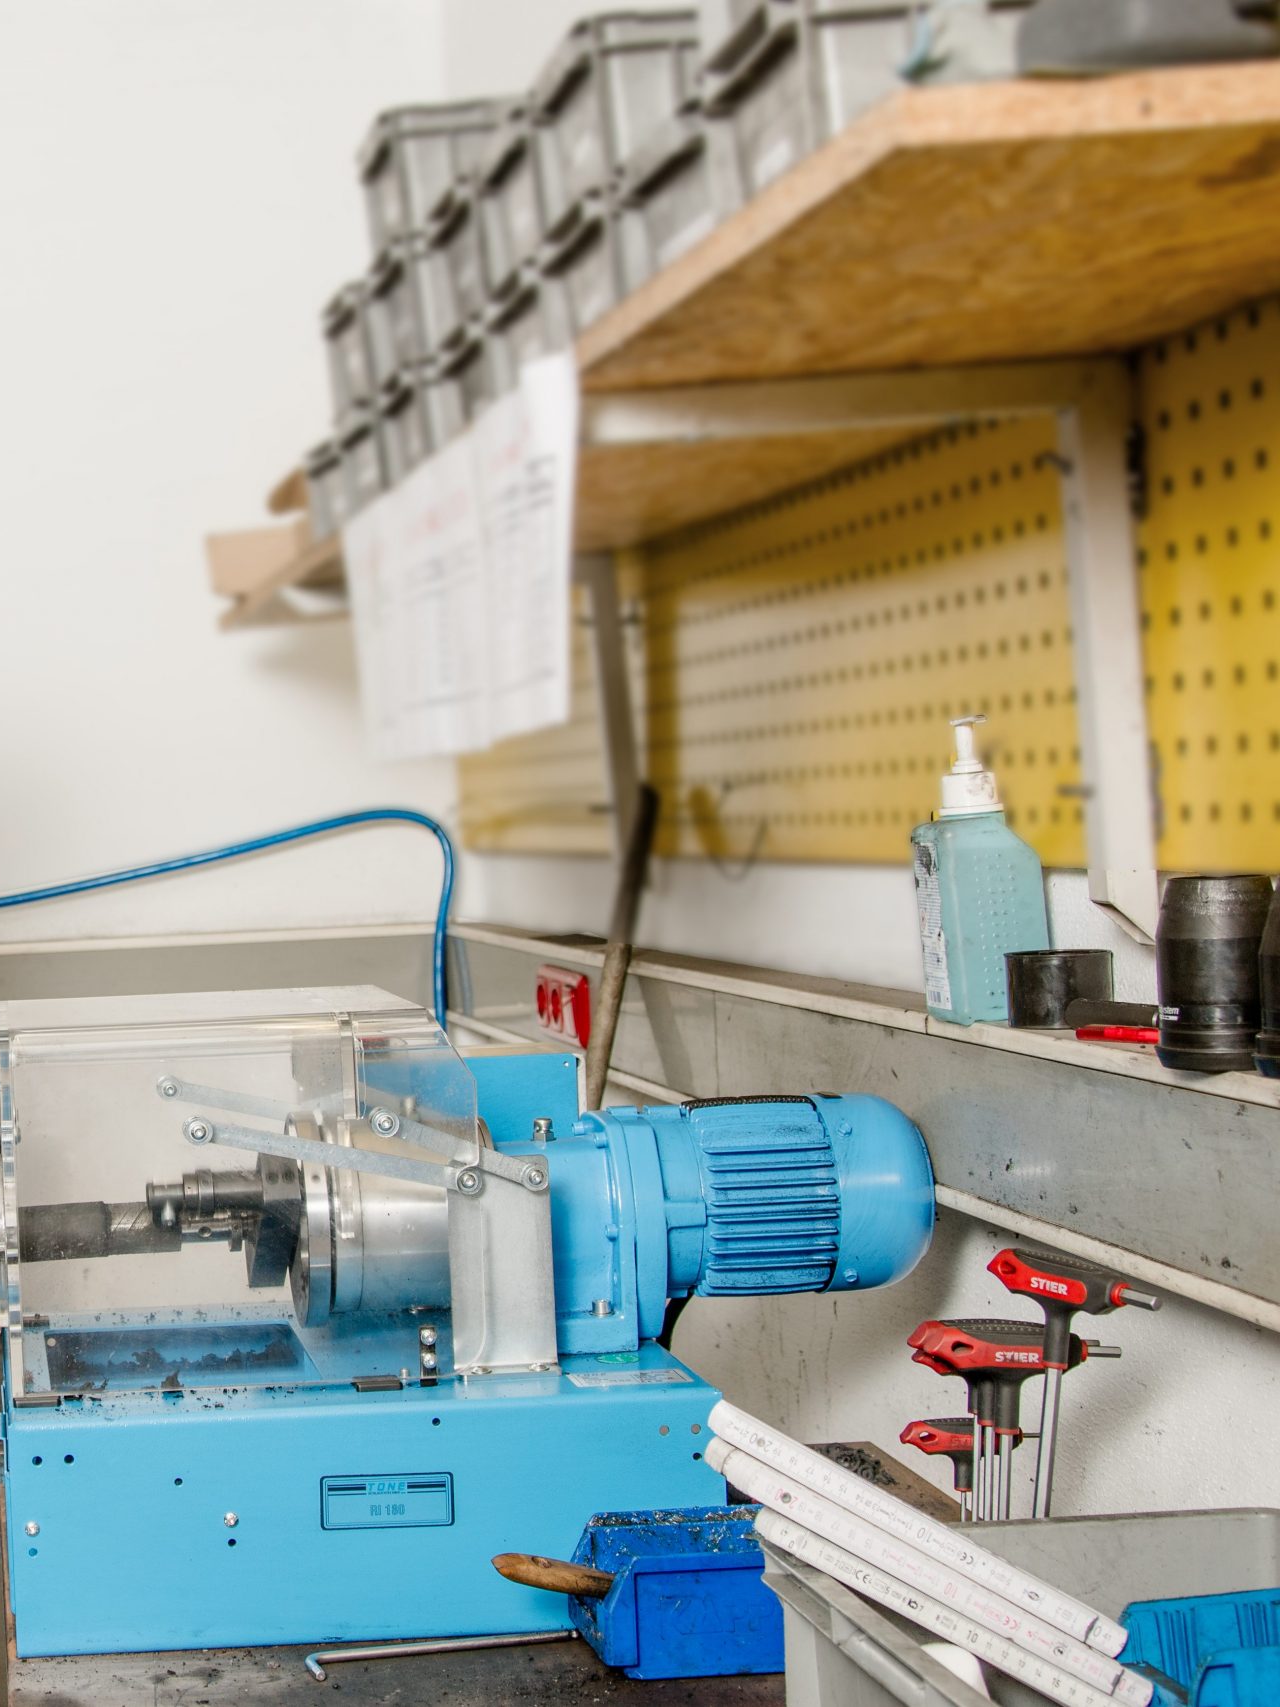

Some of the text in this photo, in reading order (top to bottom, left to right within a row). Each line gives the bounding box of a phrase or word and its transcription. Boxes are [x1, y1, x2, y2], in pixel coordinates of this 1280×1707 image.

[1030, 1277, 1068, 1295] STIER
[995, 1351, 1039, 1363] STIER
[368, 1481, 406, 1492] TONE
